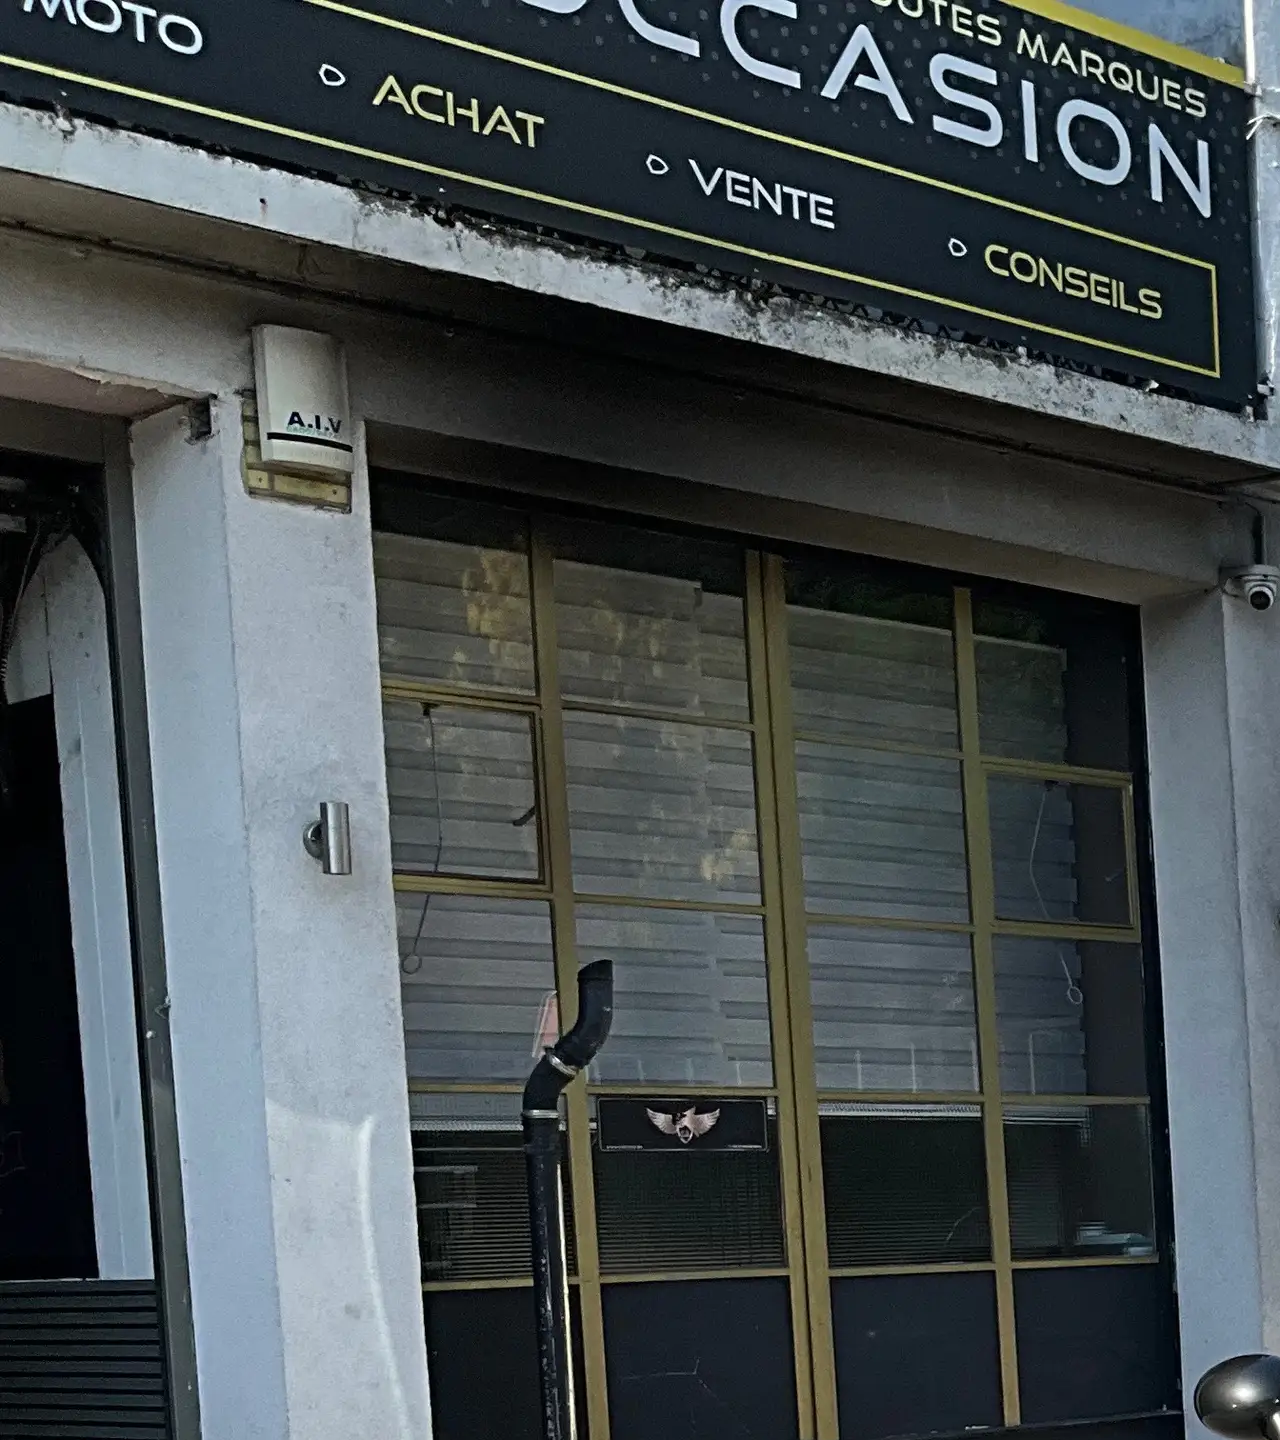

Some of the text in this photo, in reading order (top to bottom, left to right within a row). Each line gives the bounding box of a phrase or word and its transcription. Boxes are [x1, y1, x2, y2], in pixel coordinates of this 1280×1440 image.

[518, 0, 1212, 219] CCASION
[872, 0, 1207, 118] UTES MARQUES
[372, 75, 545, 148] ACHAT
[688, 158, 836, 229] VENTE
[984, 244, 1163, 319] CONSEILS
